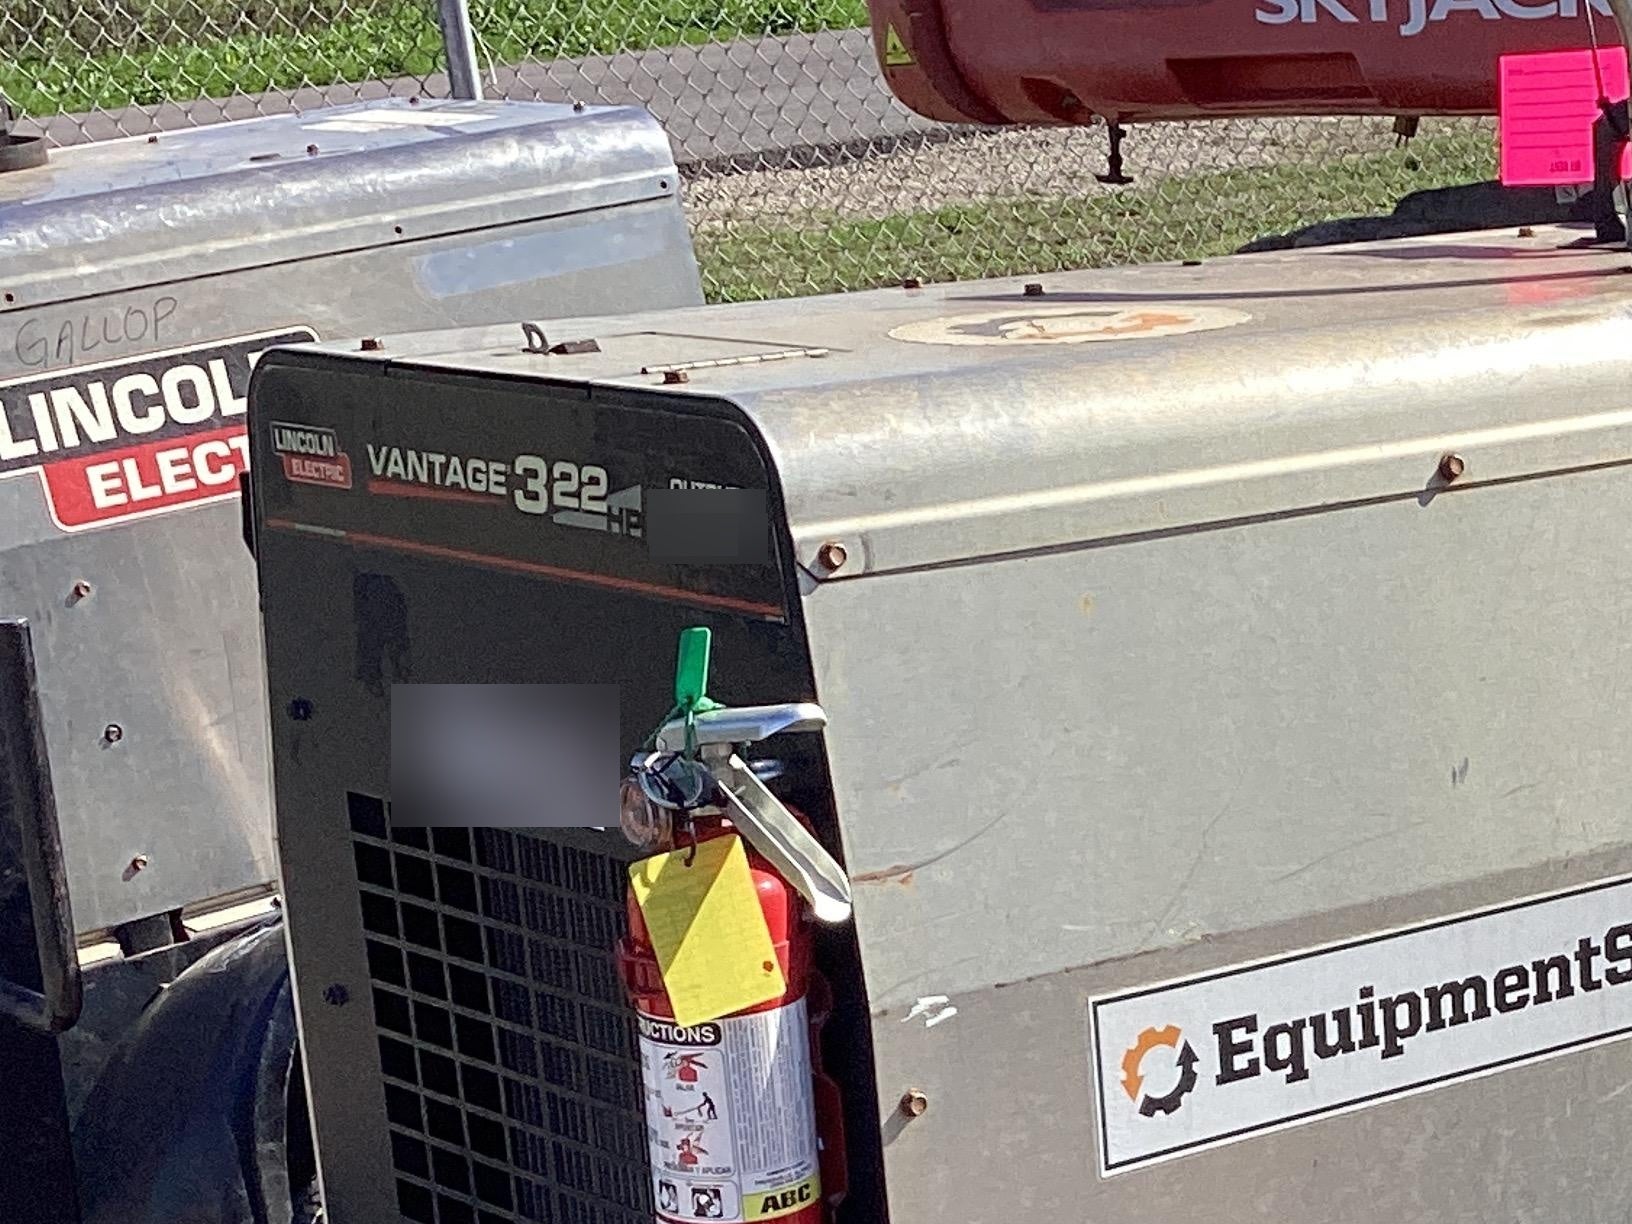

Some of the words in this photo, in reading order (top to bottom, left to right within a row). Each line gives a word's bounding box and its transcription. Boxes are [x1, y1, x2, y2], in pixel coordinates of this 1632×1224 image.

[15, 297, 178, 368] GALLOP
[0, 350, 262, 460] LINCOL
[274, 428, 336, 458] LINCOLN
[366, 443, 508, 496] VANTAGE
[513, 454, 608, 515] 322
[760, 1183, 811, 1215] ABC
